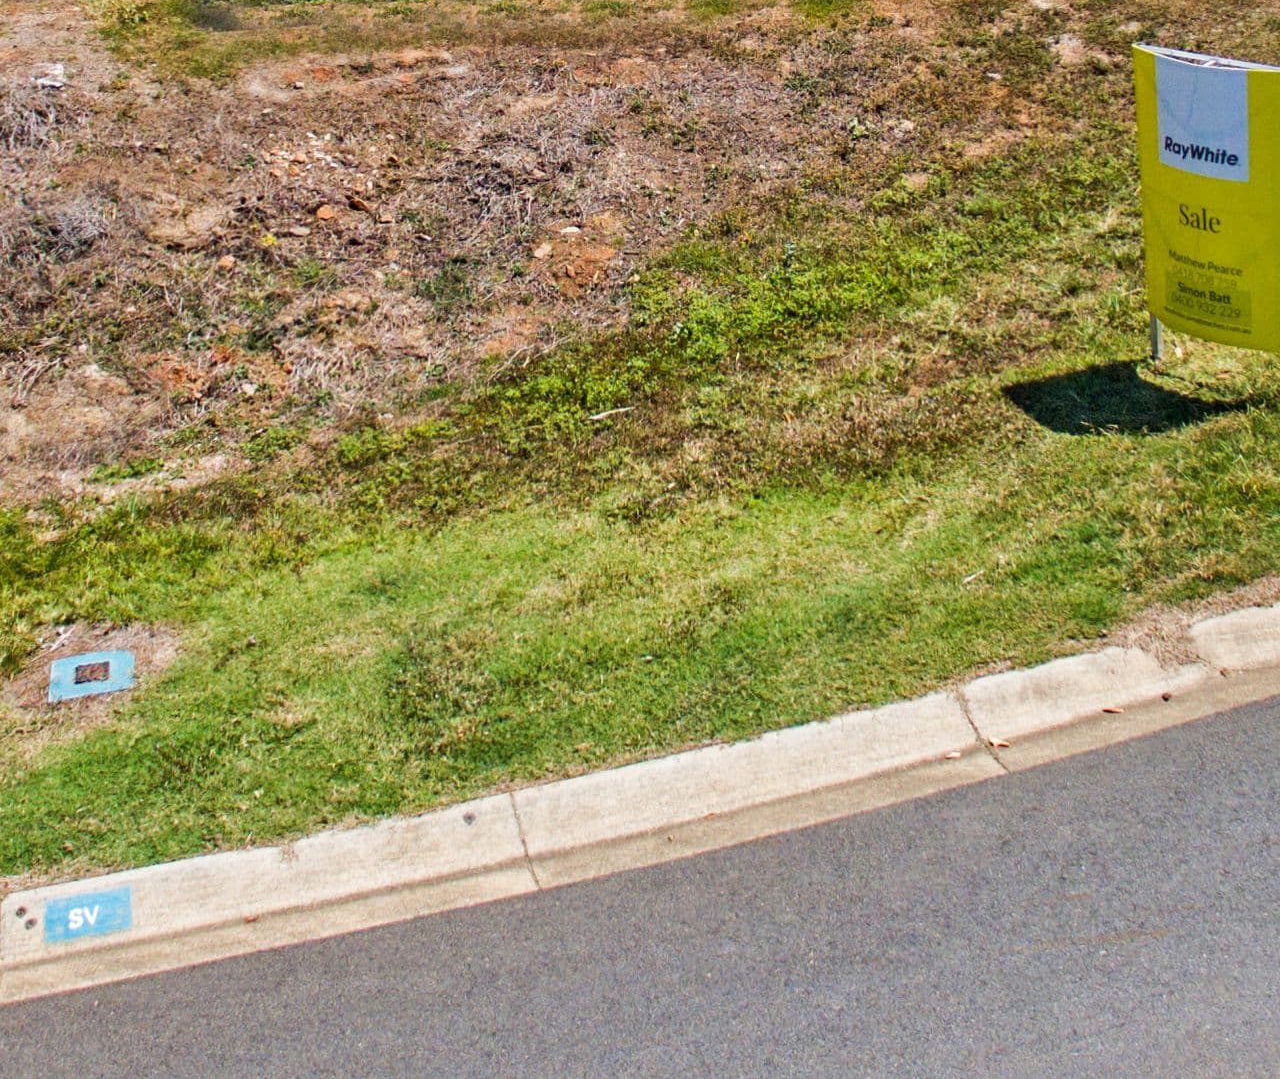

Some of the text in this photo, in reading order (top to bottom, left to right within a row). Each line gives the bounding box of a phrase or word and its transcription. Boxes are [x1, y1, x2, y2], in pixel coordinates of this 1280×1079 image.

[1179, 203, 1221, 234] Sale
[1207, 261, 1244, 277] Pearce
[1177, 281, 1232, 305] Simon Batt
[68, 904, 100, 931] SV
